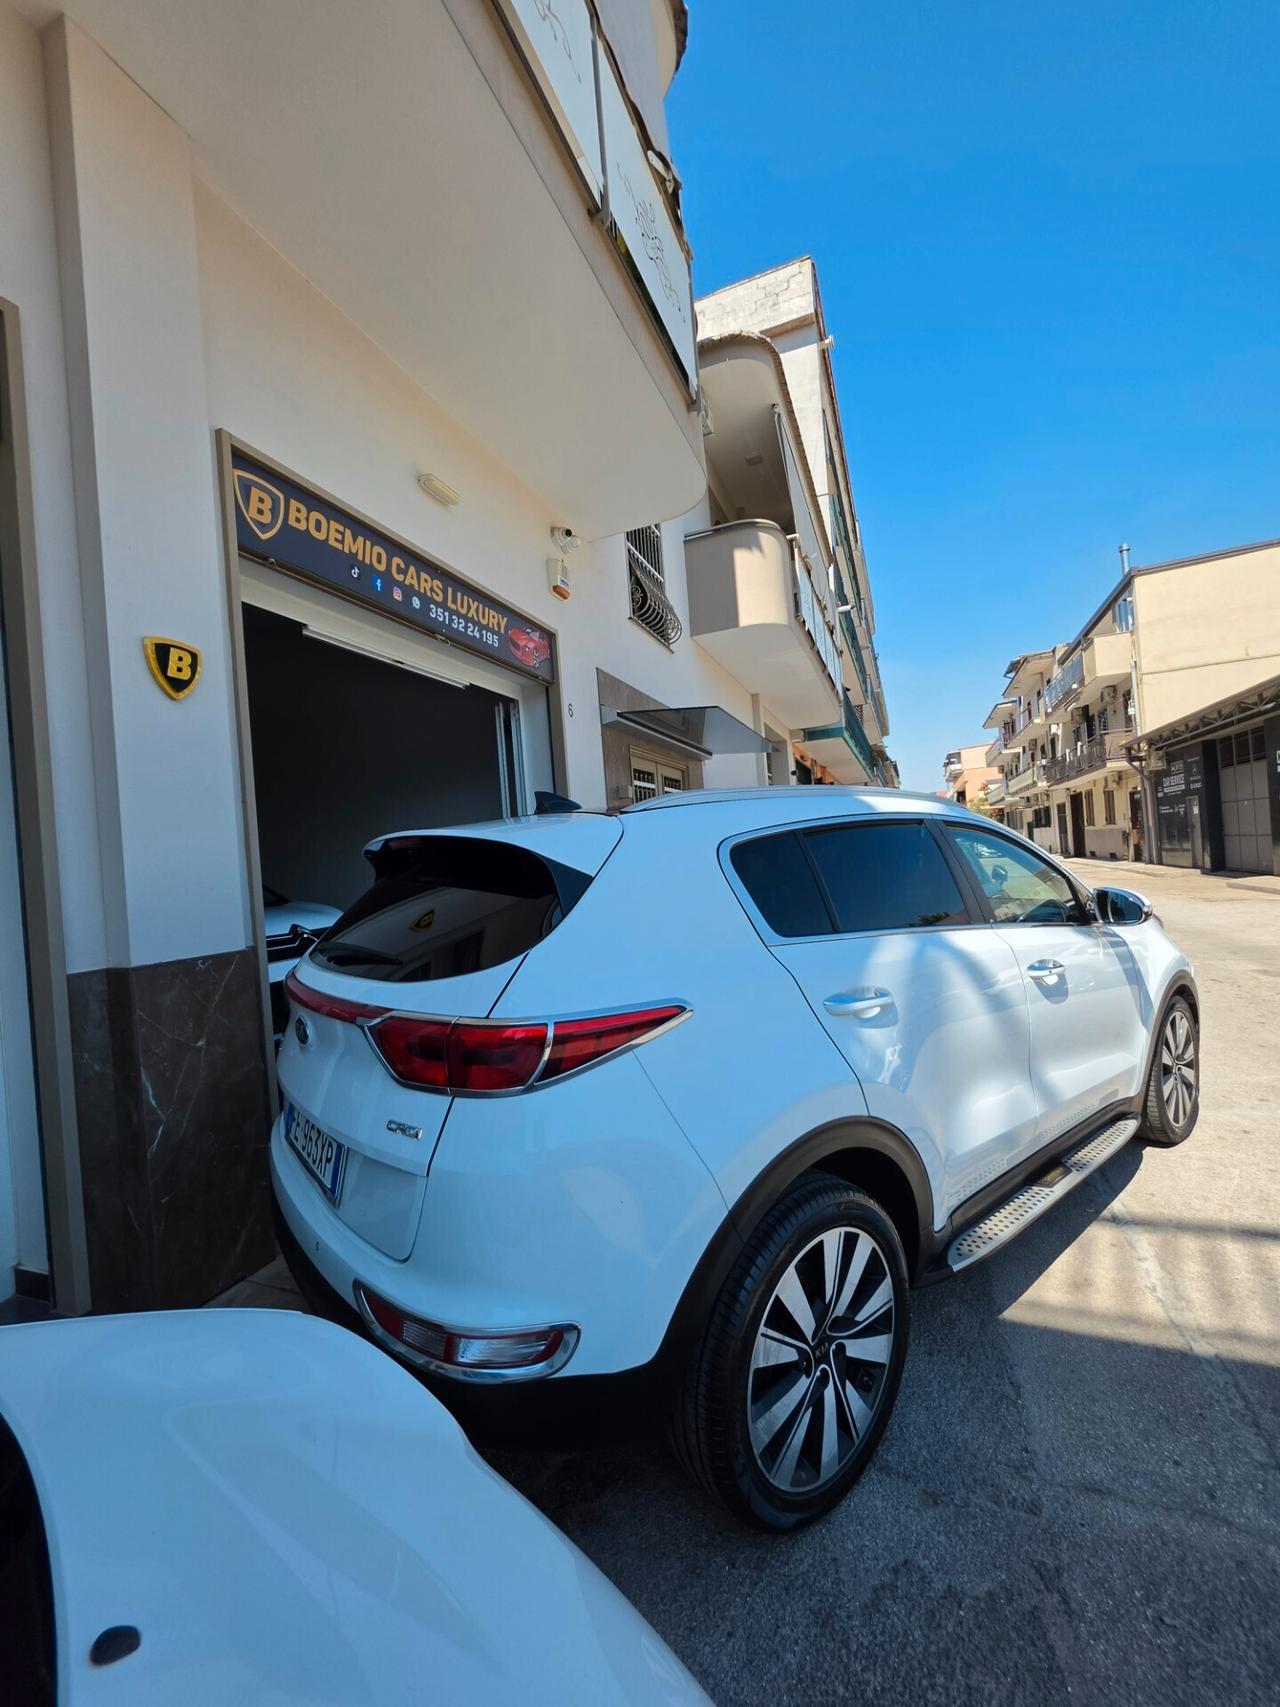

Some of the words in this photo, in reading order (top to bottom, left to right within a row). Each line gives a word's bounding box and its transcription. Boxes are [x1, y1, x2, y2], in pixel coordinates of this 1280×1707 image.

[249, 486, 272, 525] B
[287, 498, 387, 572] BOEMIO
[391, 556, 443, 602] CARS
[447, 587, 508, 634] LUXURY
[429, 604, 449, 625] 351
[451, 615, 465, 633] 32
[467, 623, 480, 639] 24
[482, 630, 499, 648] 195
[166, 647, 192, 681] B
[567, 703, 574, 719] 6
